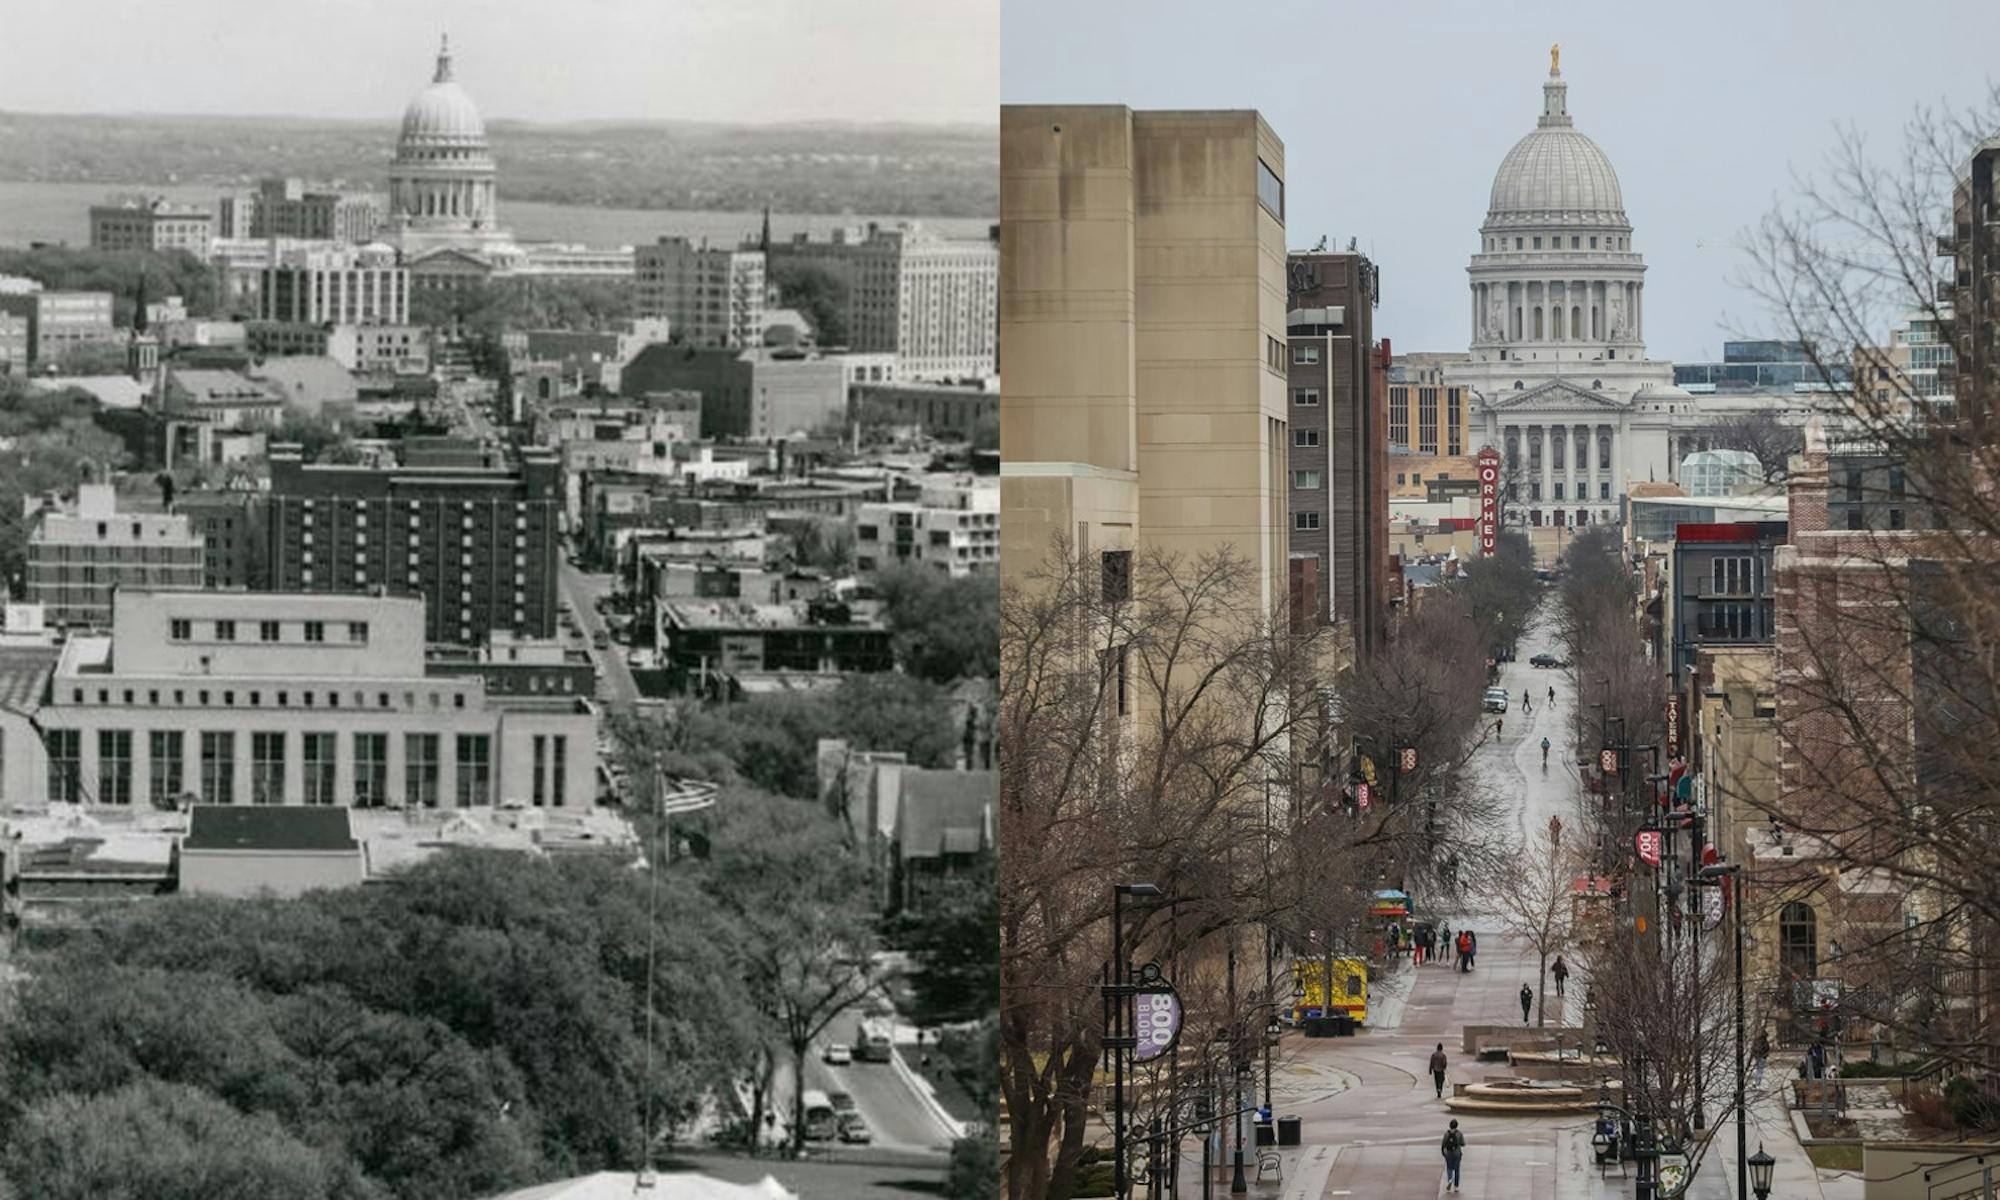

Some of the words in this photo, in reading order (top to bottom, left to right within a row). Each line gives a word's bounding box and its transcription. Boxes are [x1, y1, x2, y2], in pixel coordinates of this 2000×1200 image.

[1669, 702, 1677, 743] TAVERN
[1640, 833, 1651, 860] 700
[1138, 1004, 1151, 1046] BLOCK
[1151, 993, 1173, 1045] 800
